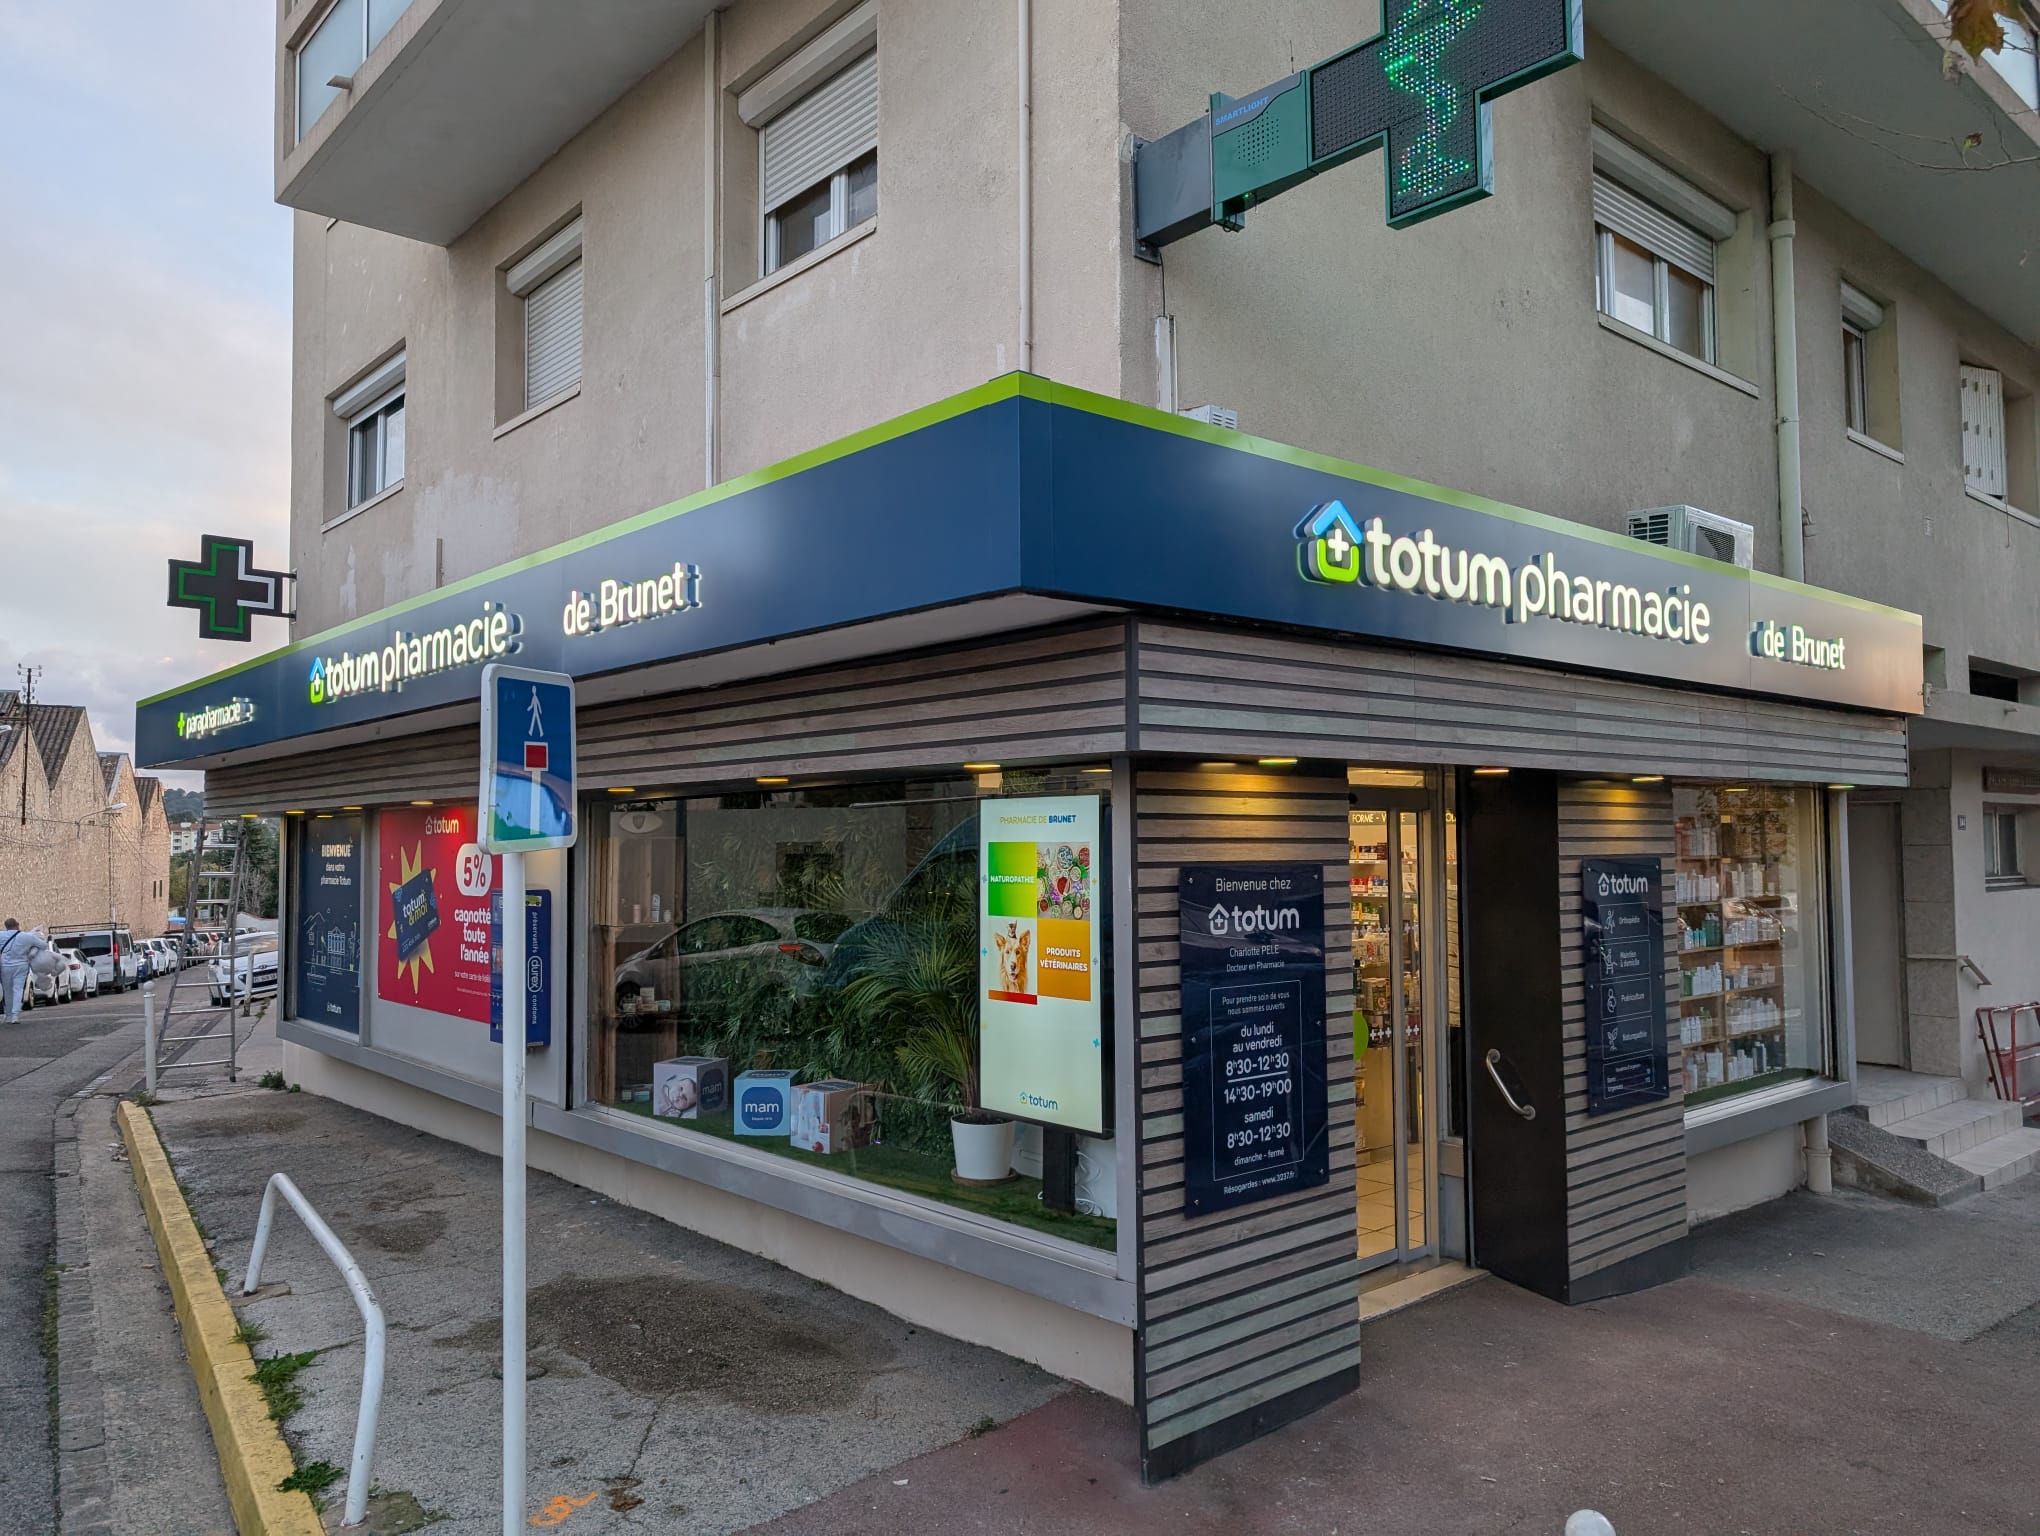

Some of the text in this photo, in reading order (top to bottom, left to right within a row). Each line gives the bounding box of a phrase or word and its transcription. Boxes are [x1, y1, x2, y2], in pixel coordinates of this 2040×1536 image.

[1215, 96, 1269, 126] SMARTLIGHT
[1367, 517, 1711, 644] totum pharmacie
[563, 562, 685, 636] de Brunet
[325, 601, 508, 698] totum pharmacie
[1762, 622, 1846, 670] de Brunet
[186, 697, 241, 740] parapharmacie
[433, 816, 459, 834] totum
[1000, 814, 1077, 824] PHARMACIE DE BRUNET
[1352, 813, 1374, 823] FORME
[321, 844, 351, 857] BIENVENUE
[464, 854, 486, 888] 5%
[990, 875, 1035, 884] NATUROPATHIE
[1215, 876, 1292, 892] Bienvenue chez
[1610, 874, 1649, 894] totum
[402, 892, 425, 918] totum
[454, 908, 491, 926] cagnotté
[1231, 904, 1300, 932] totum
[463, 925, 486, 944] toute
[531, 911, 539, 953] préservatifs
[460, 943, 489, 964] l'année
[1046, 947, 1081, 958] PRODUITS
[1229, 947, 1260, 958] Charlotte
[530, 957, 541, 990] durex
[1039, 958, 1089, 972] VÉTÉRINAIRES
[1226, 963, 1248, 972] Docteur
[1256, 960, 1285, 970] Pharmacie
[1222, 996, 1235, 1005] Pour
[1236, 994, 1257, 1005] prendre
[1227, 1008, 1242, 1016] nous
[1242, 1005, 1265, 1014] sommes
[1240, 1021, 1275, 1037] du lundi
[1232, 1035, 1282, 1053] au vendredi
[702, 1082, 722, 1095] mam
[744, 1103, 779, 1113] mam
[1029, 1093, 1058, 1111] totum
[1244, 1106, 1274, 1124] samedi
[1234, 1152, 1263, 1166] dimanche
[1267, 1146, 1285, 1158] fermé
